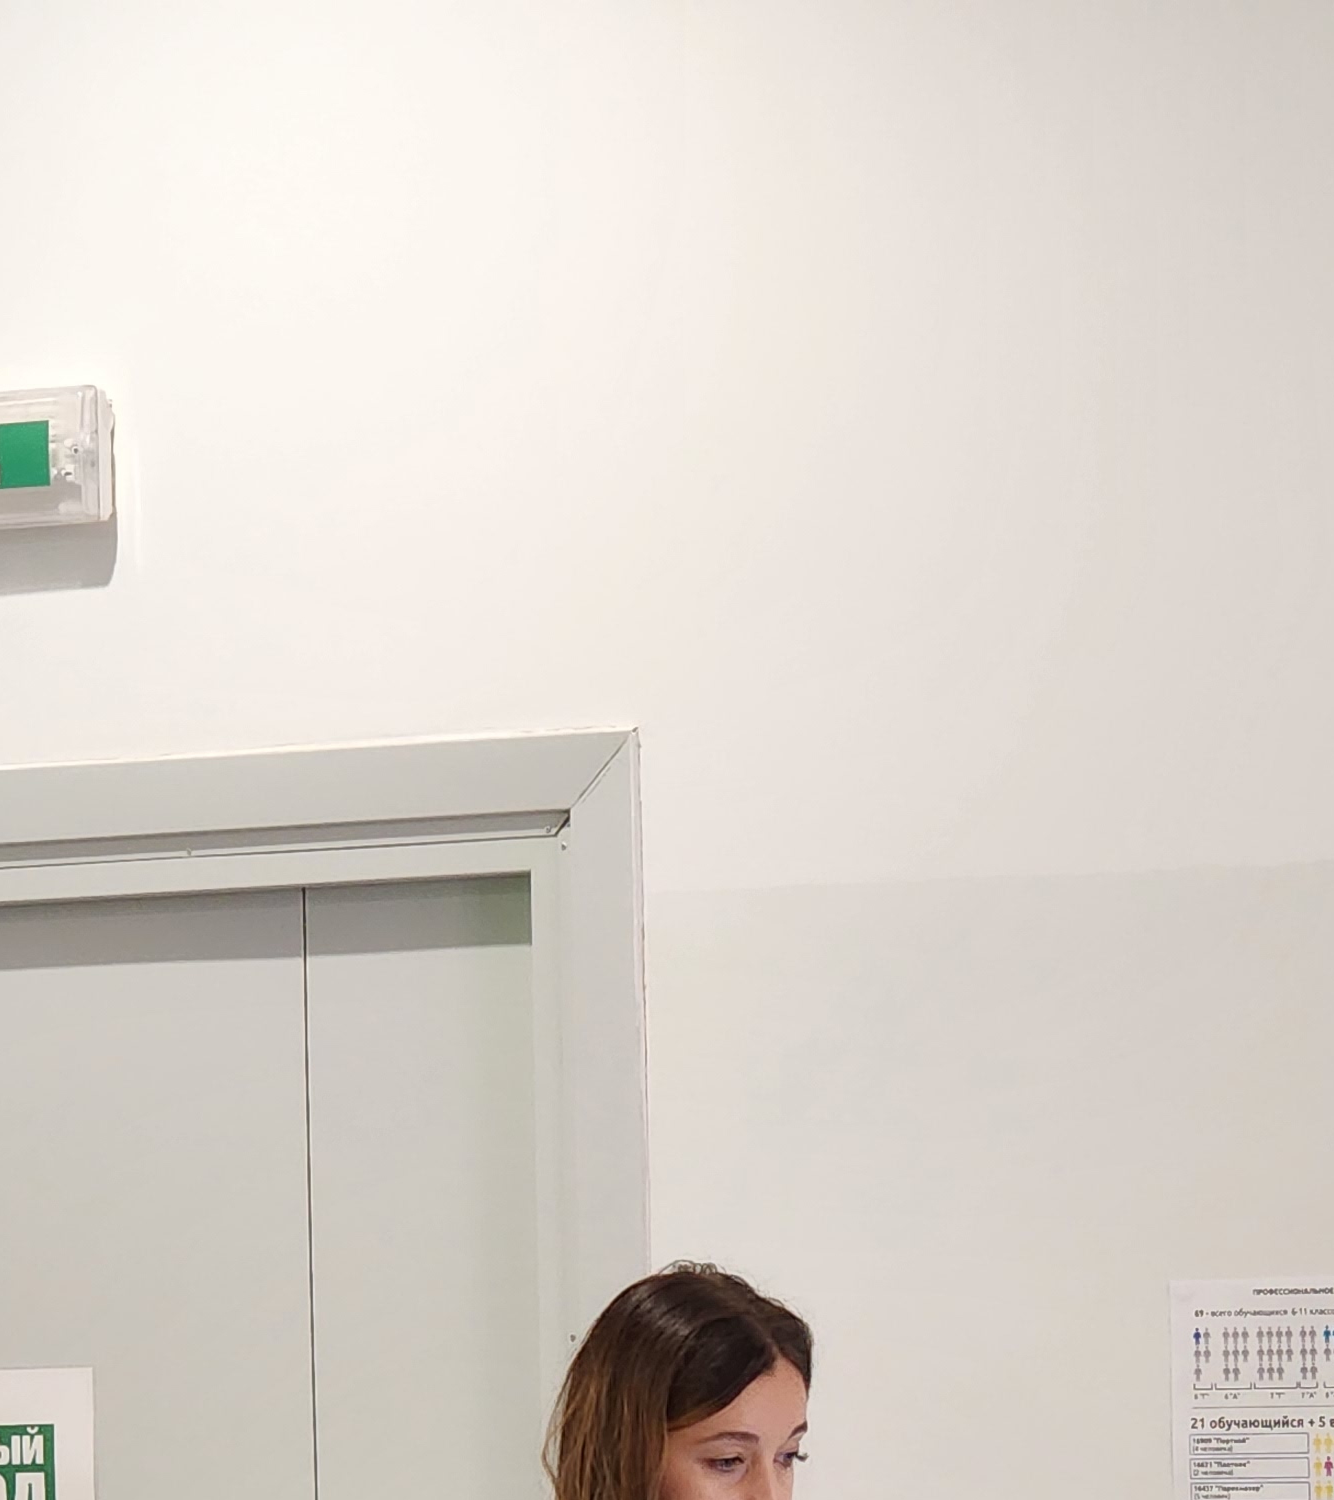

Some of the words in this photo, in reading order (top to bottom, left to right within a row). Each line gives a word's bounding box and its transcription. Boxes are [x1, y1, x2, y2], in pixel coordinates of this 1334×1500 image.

[1190, 1417, 1205, 1430] 21
[1209, 1415, 1304, 1433] обучающийся
[1318, 1416, 1326, 1427] 5
